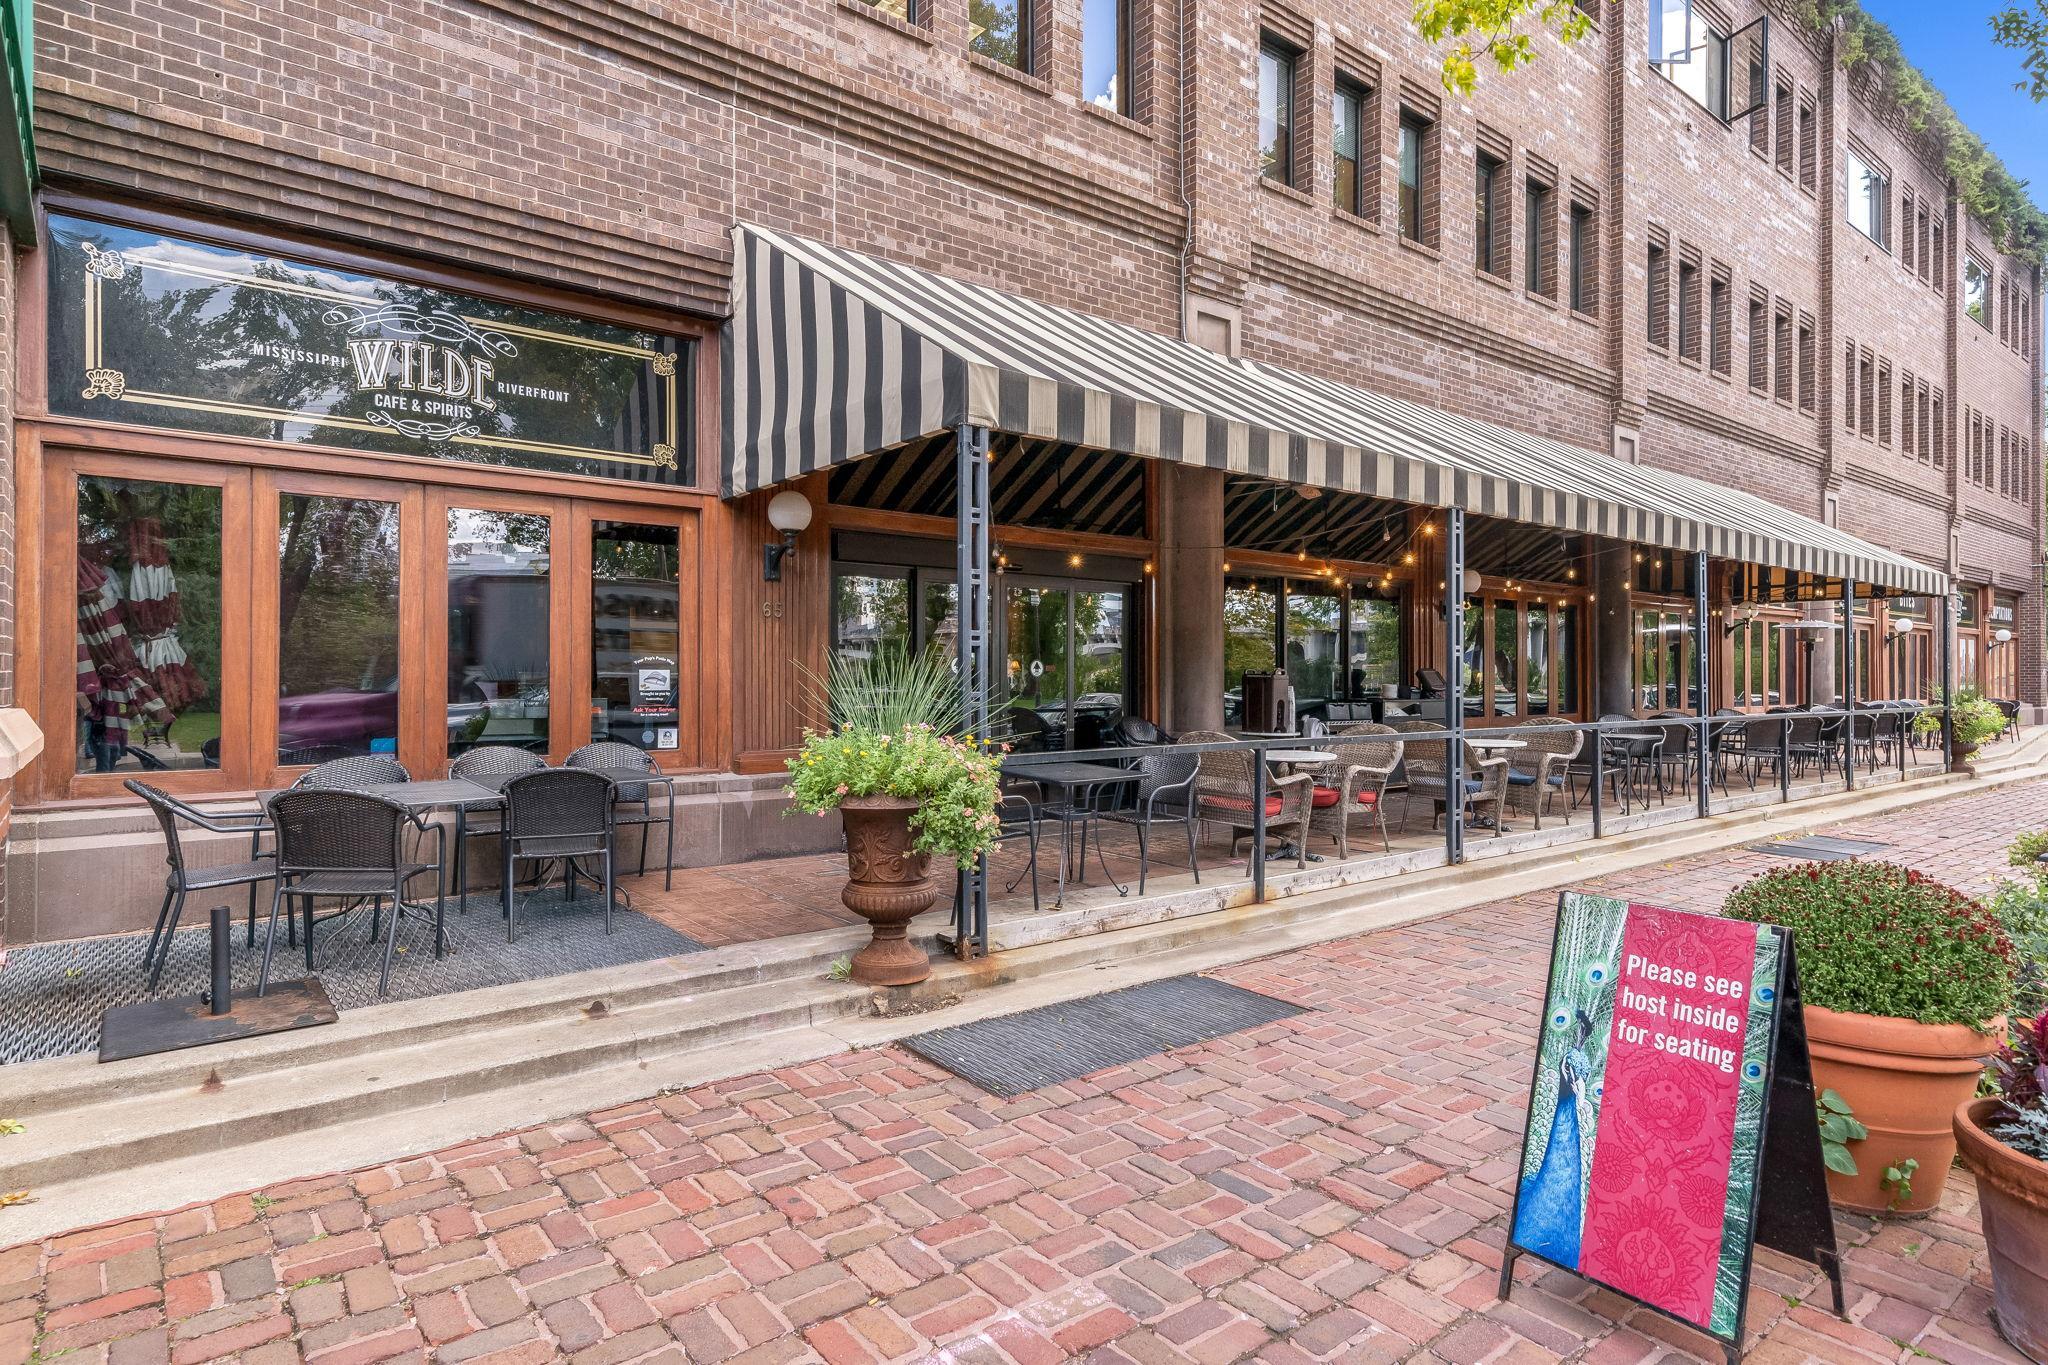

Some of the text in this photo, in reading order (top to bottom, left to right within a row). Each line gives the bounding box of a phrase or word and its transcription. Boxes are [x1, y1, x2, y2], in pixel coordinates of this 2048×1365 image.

[253, 344, 346, 368] MISSISSIPPI
[347, 338, 497, 411] WILDE
[498, 381, 570, 403] RIVERFRONT
[374, 393, 473, 419] CAFE & SPIRITS
[763, 602, 782, 618] 65
[1626, 954, 1743, 999] Please see
[1622, 986, 1739, 1034] host inside
[1617, 1019, 1736, 1074] for seating
